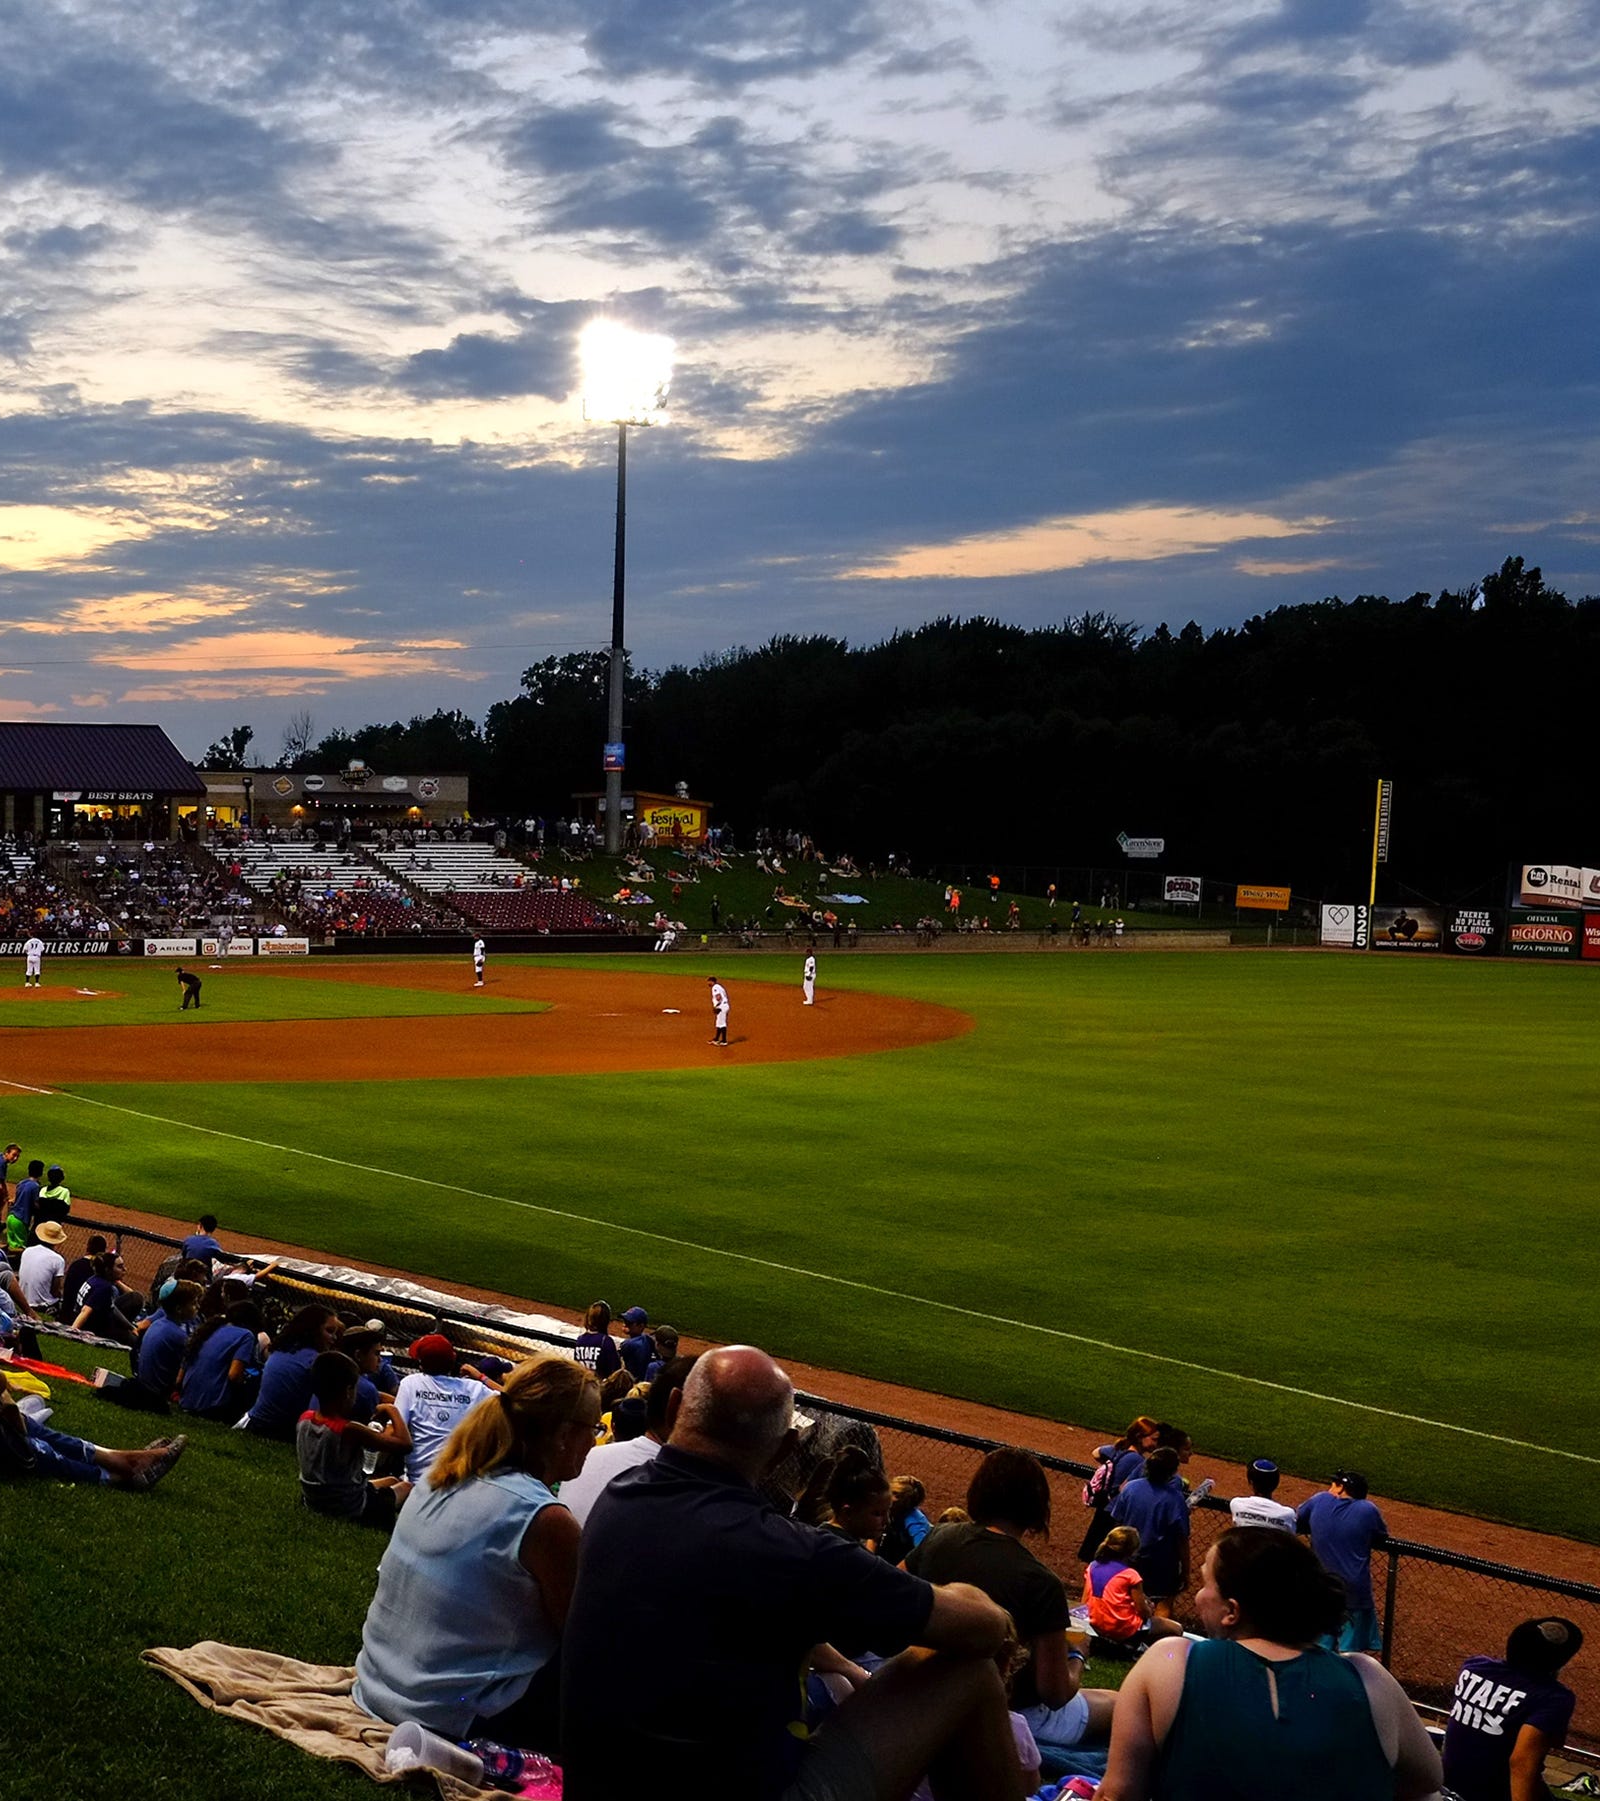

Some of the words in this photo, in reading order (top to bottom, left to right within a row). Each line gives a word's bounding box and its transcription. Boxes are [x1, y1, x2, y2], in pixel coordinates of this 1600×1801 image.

[88, 791, 117, 799] BEST
[118, 792, 154, 800] SEATS
[1530, 869, 1545, 880] CAT
[1550, 875, 1581, 889] Rental
[1458, 910, 1490, 919] THERE'S
[1526, 915, 1558, 923] OFFICIAL
[1455, 917, 1466, 926] NO
[1467, 918, 1491, 927] PLACE
[1450, 924, 1468, 933] LIKE
[1512, 944, 1533, 952] PIZZA
[1534, 945, 1569, 953] PROVIDER
[575, 1346, 602, 1360] STAFF
[415, 1390, 453, 1402] WISCONSIN
[454, 1394, 471, 1405] HERD
[1454, 1669, 1527, 1716] STAFF
